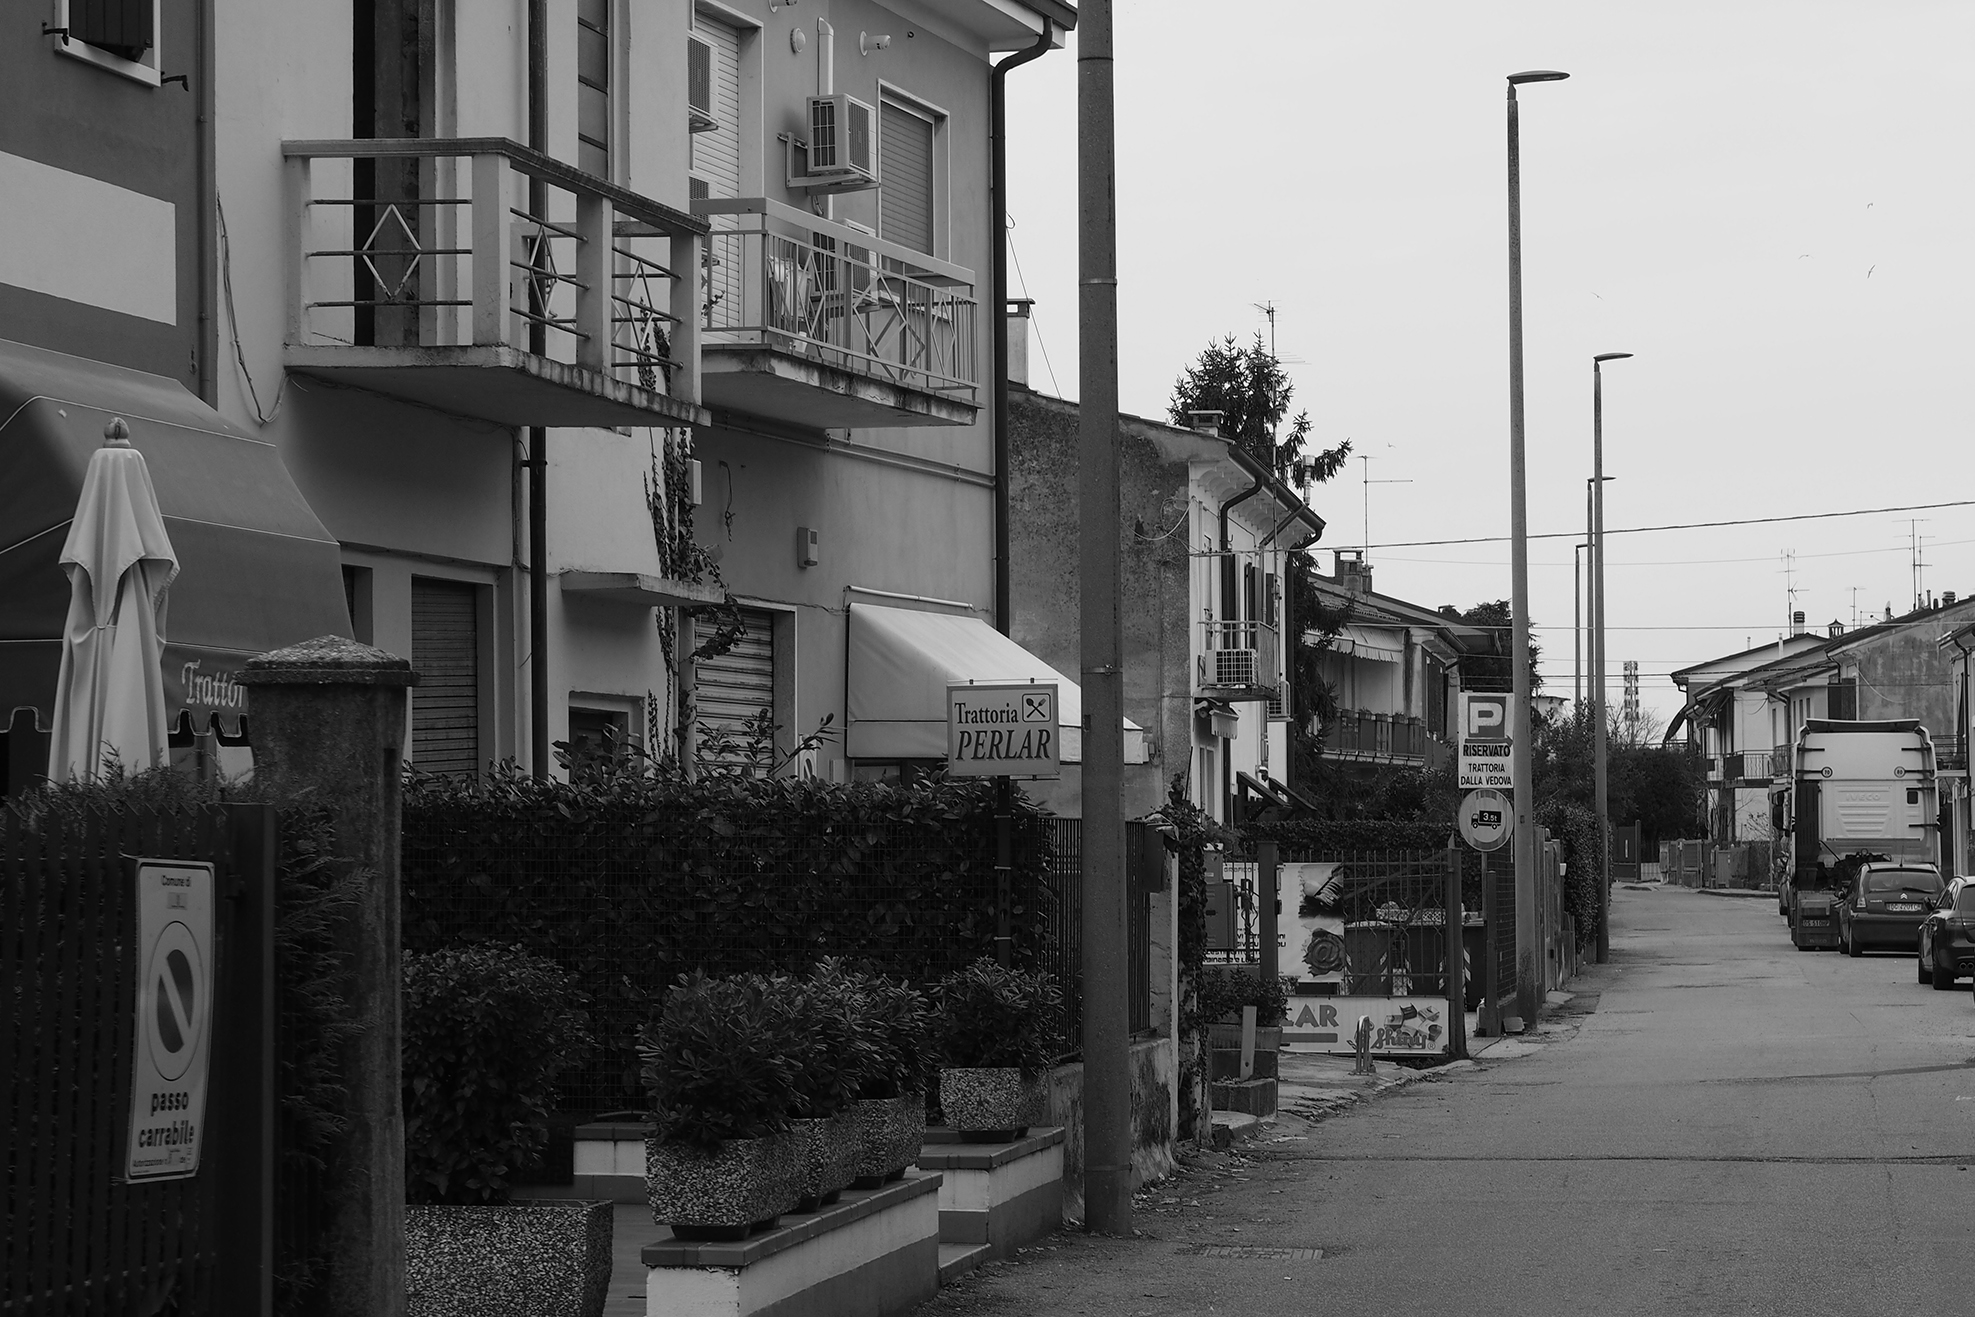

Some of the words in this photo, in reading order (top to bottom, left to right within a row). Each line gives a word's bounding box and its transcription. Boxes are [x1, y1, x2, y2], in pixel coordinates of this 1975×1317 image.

[954, 702, 1019, 724] Trattoria
[1469, 702, 1504, 734] P
[955, 728, 1052, 760] PERLAR
[1462, 744, 1511, 757] RISERVATO
[1468, 762, 1506, 773] TRATTORIA
[1460, 775, 1483, 786] DALLA
[1485, 775, 1512, 786] VEDOVA
[1846, 793, 1881, 801] IVECO
[1482, 812, 1498, 822] 3.5t
[150, 1091, 189, 1117] passo
[138, 1119, 195, 1148] carrabile
